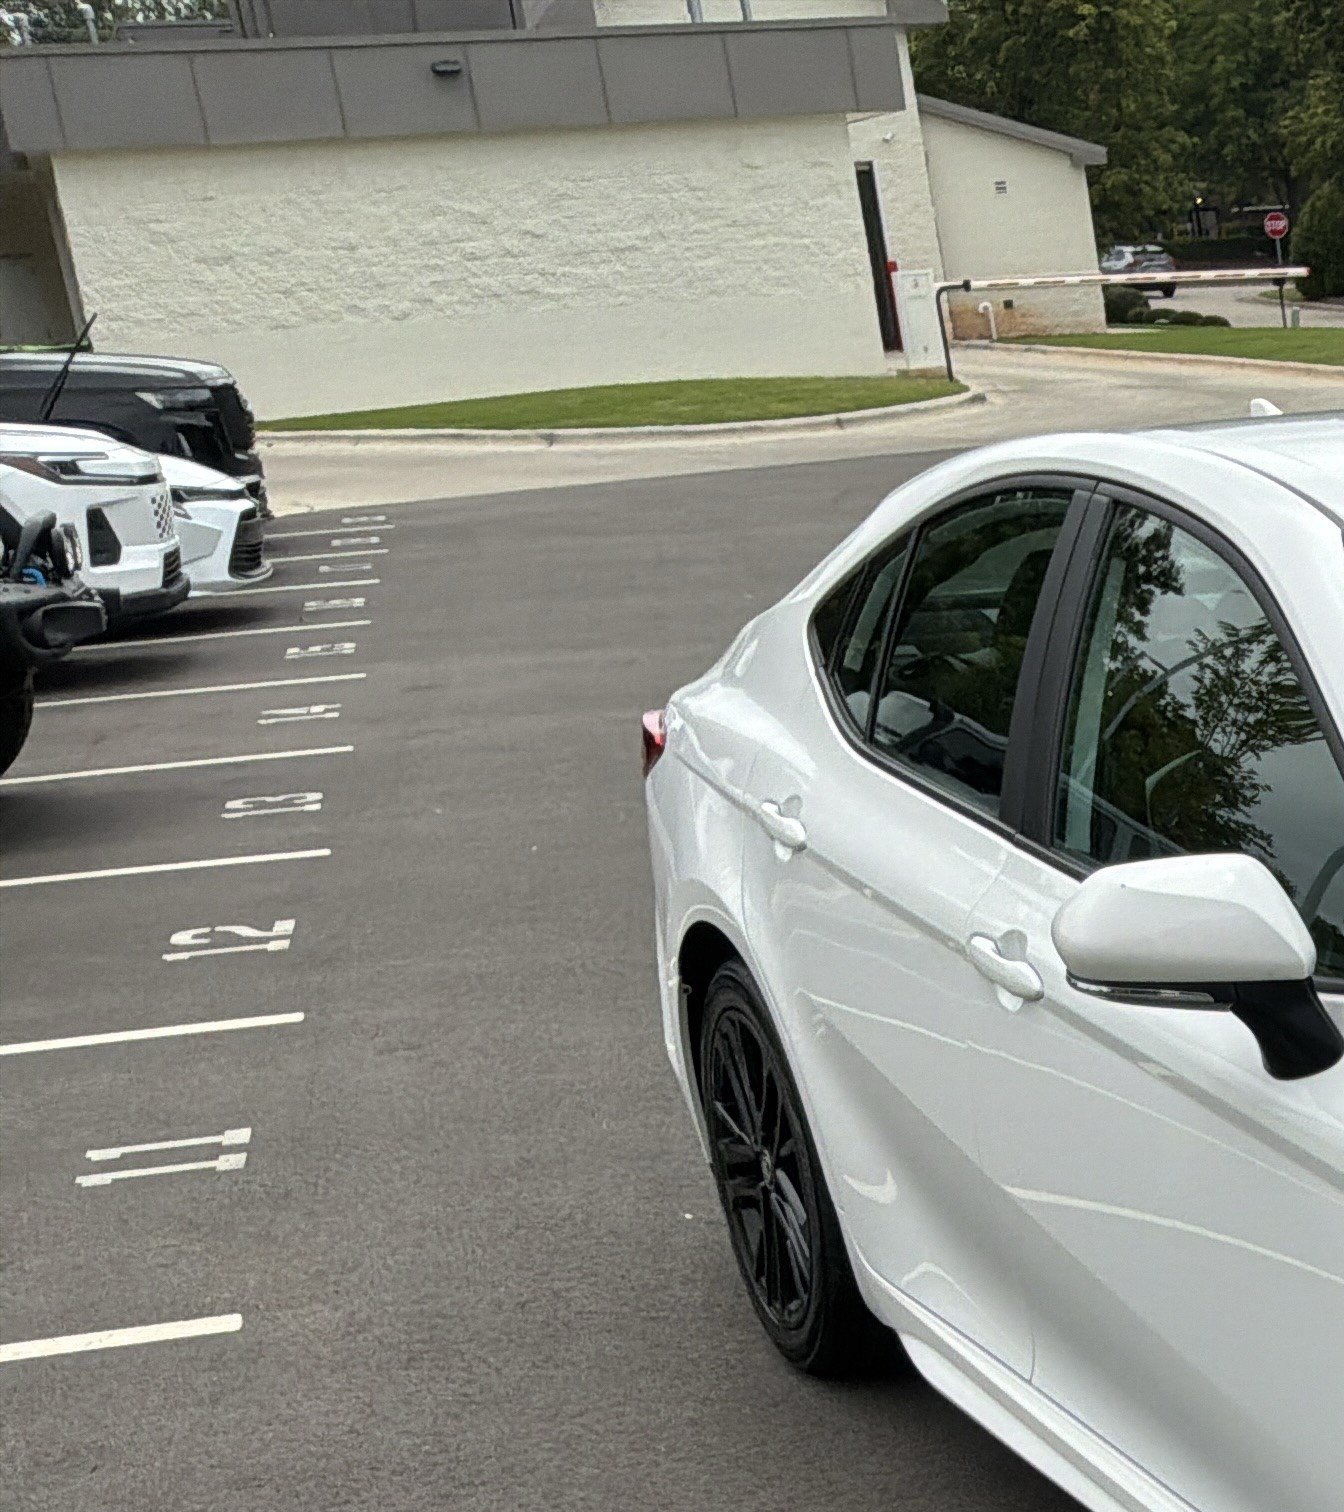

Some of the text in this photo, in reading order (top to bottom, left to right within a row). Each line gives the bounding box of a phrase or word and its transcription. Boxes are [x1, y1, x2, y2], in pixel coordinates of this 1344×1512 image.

[256, 703, 342, 725] 14
[221, 792, 324, 819] 13
[162, 918, 296, 962] 12
[75, 1126, 252, 1188] 11
